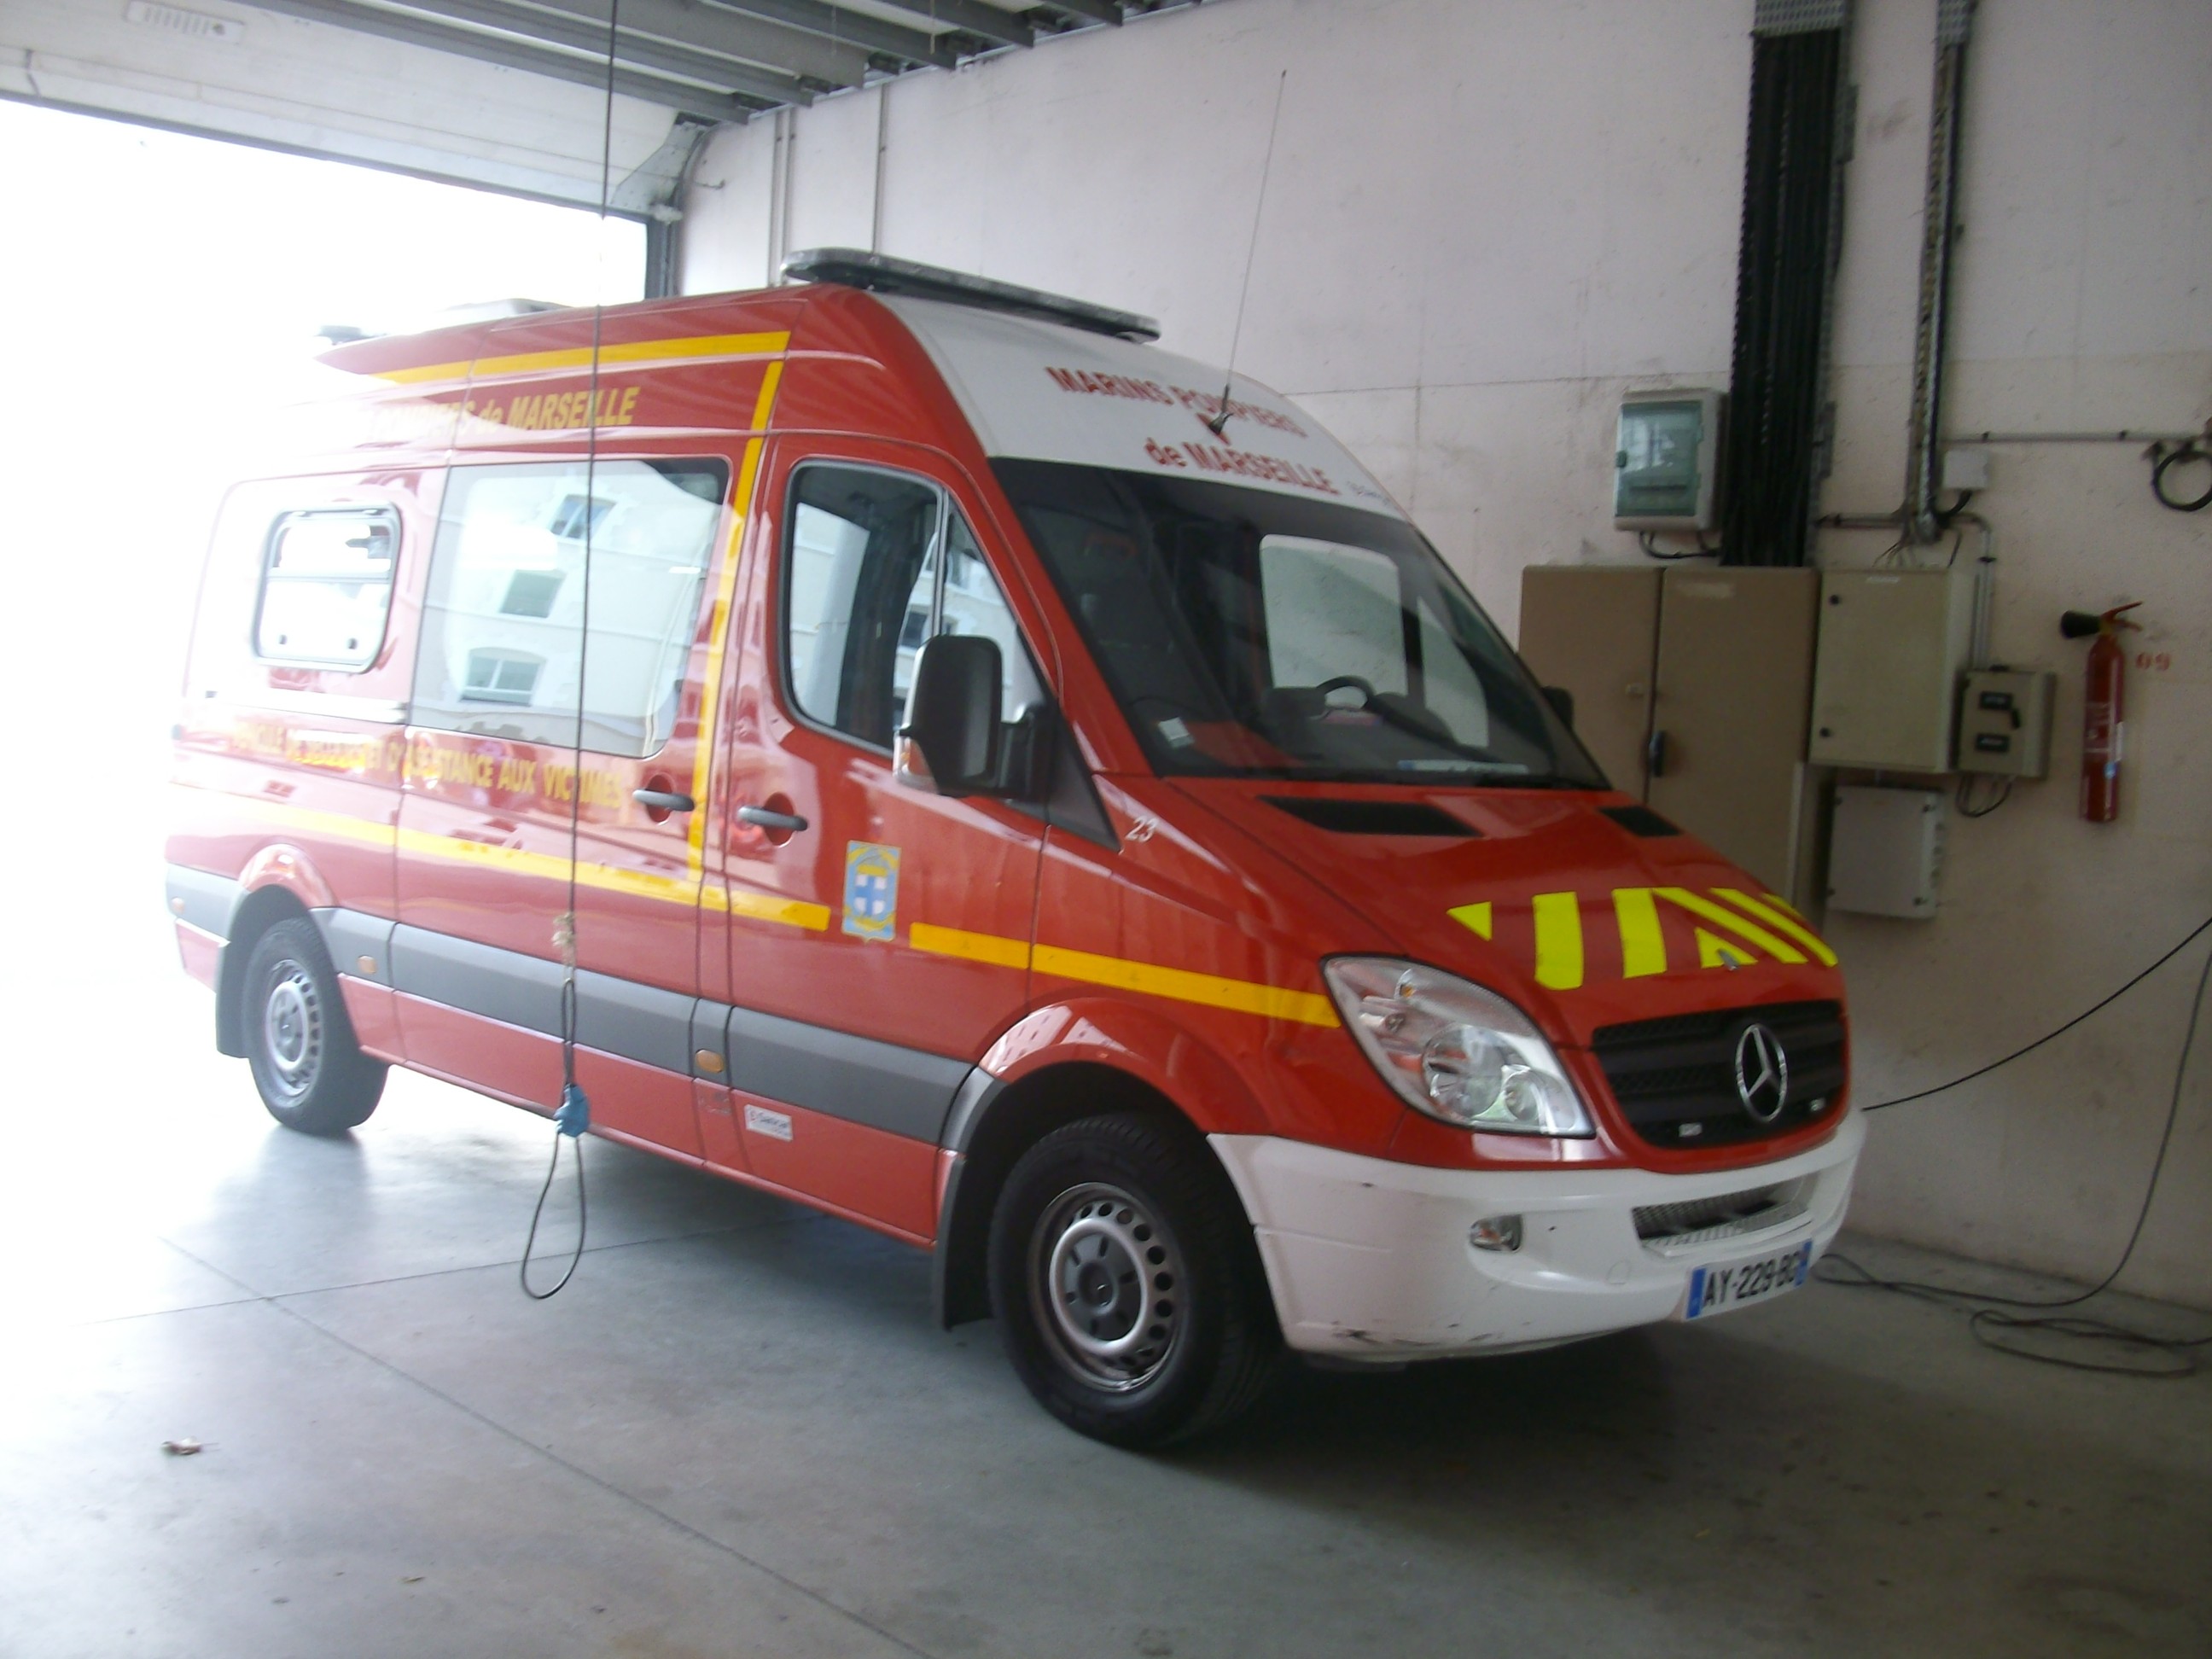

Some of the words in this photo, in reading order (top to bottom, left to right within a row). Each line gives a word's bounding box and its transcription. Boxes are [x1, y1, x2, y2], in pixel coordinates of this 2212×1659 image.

[1045, 366, 1174, 405] MARINS
[477, 399, 504, 434] de
[507, 387, 641, 431] MARSEILLE
[1144, 437, 1187, 467] de
[1182, 441, 1341, 495] MARSEILLE
[498, 759, 538, 795] AUX
[1125, 816, 1159, 843] 23
